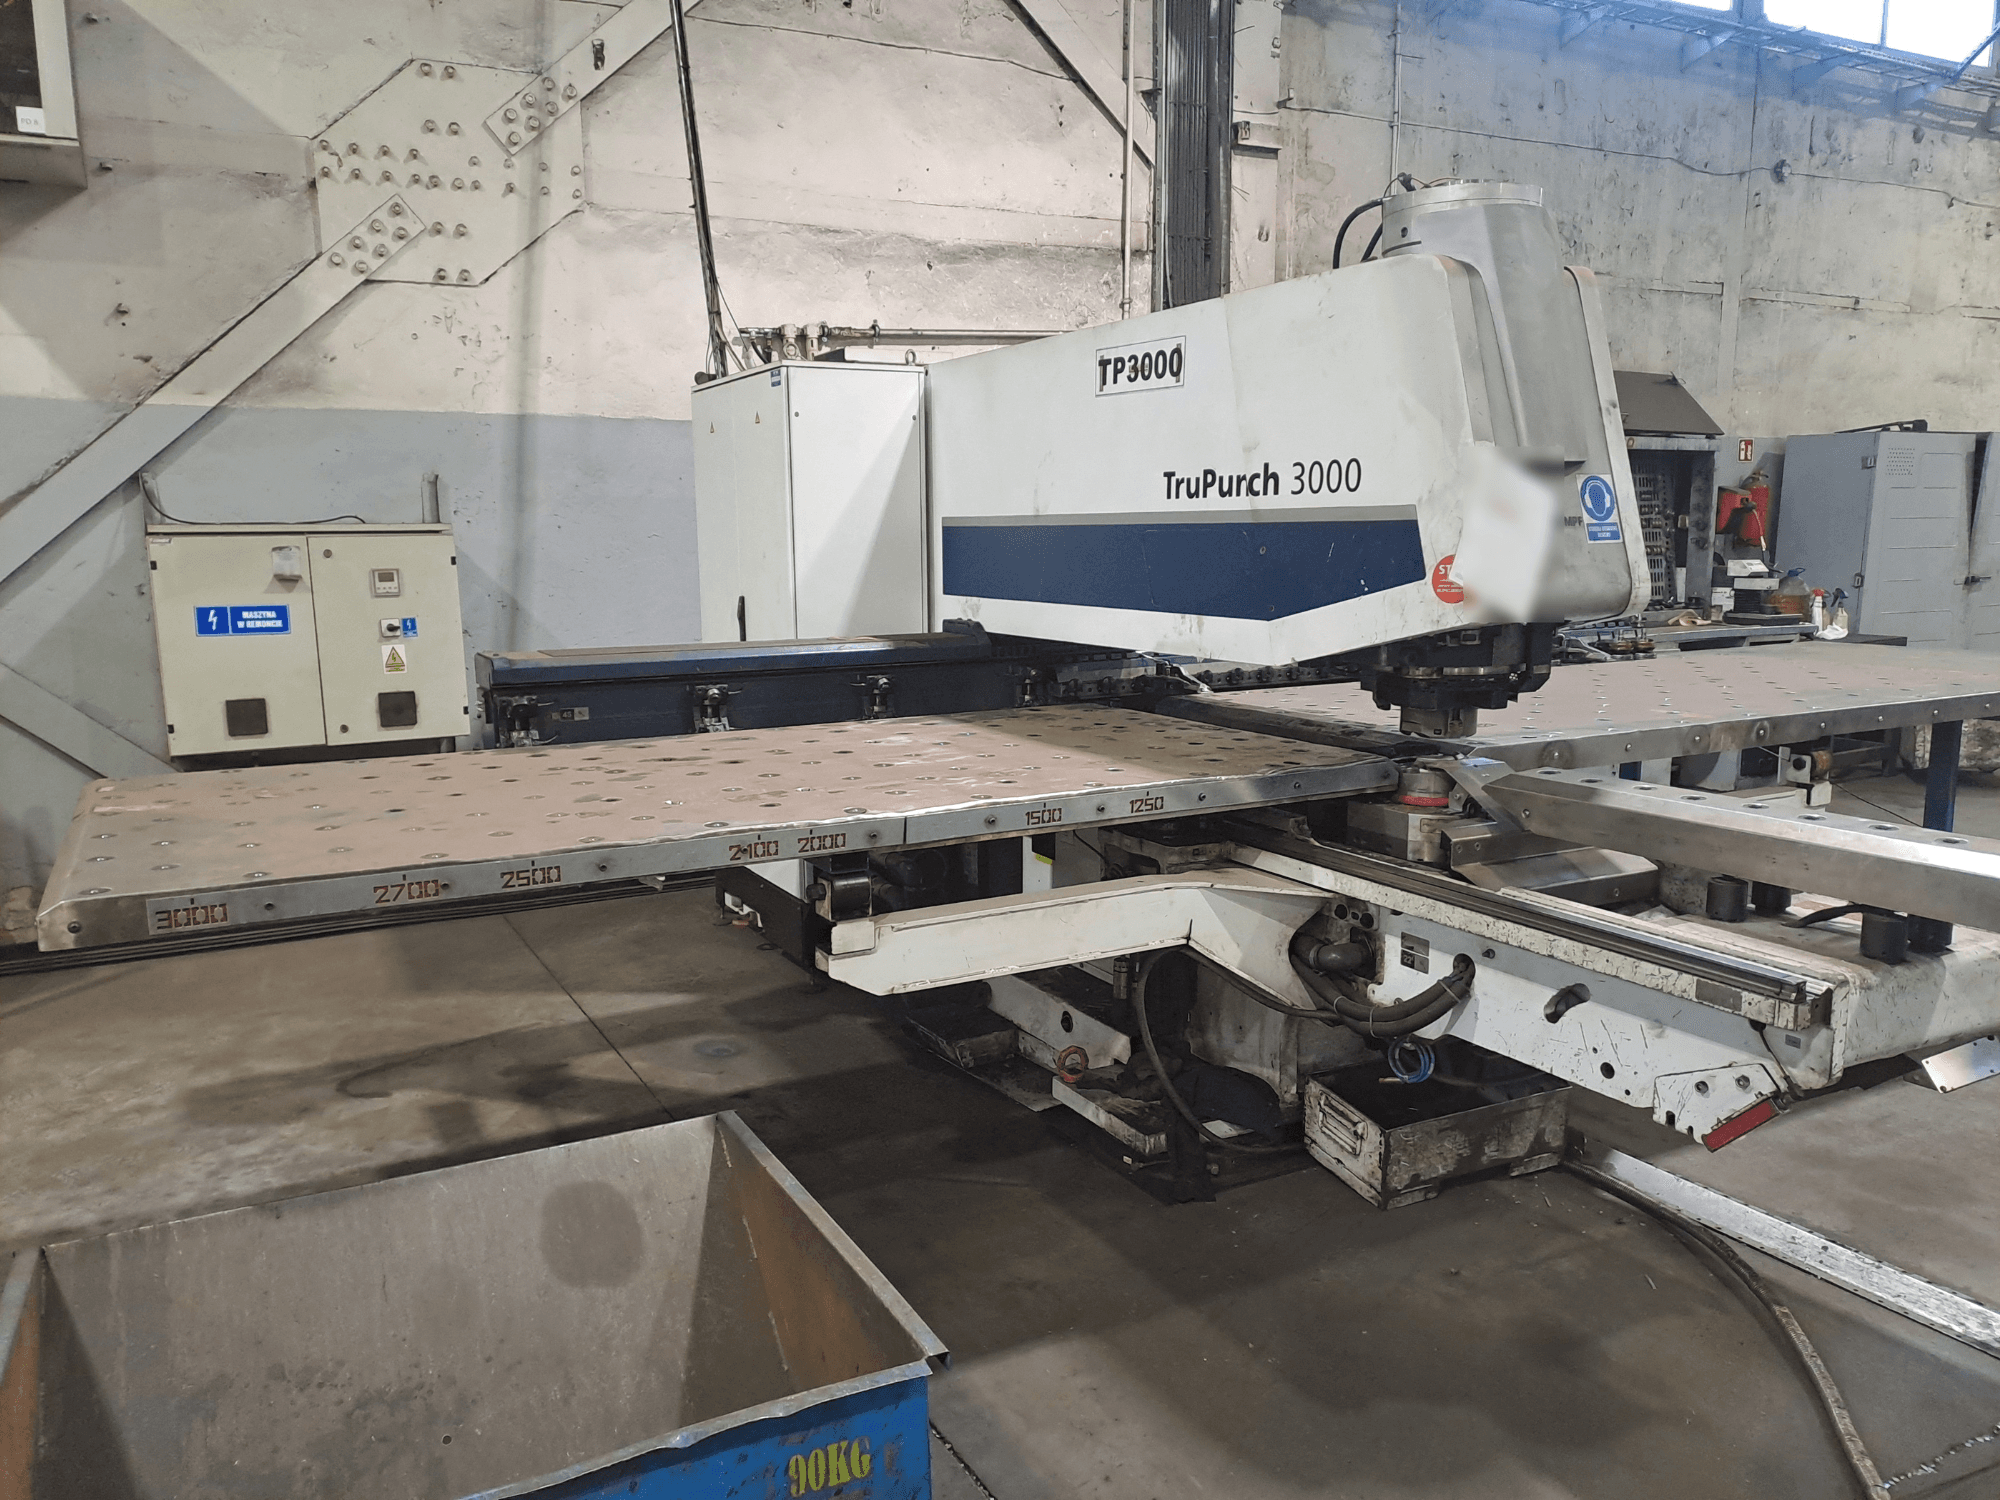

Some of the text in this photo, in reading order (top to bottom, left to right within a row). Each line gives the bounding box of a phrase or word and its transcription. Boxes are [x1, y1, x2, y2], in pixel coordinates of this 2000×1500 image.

[1098, 347, 1183, 386] TP3000
[1163, 457, 1362, 499] TruPunch 3000
[1025, 808, 1063, 826] 1500
[1129, 796, 1165, 814] 1250
[729, 840, 779, 861] 2100
[797, 832, 846, 853] 2000
[500, 865, 561, 889] 2500
[373, 879, 440, 904] 2700
[155, 903, 228, 930] 3000
[788, 1436, 871, 1498] 90KG
